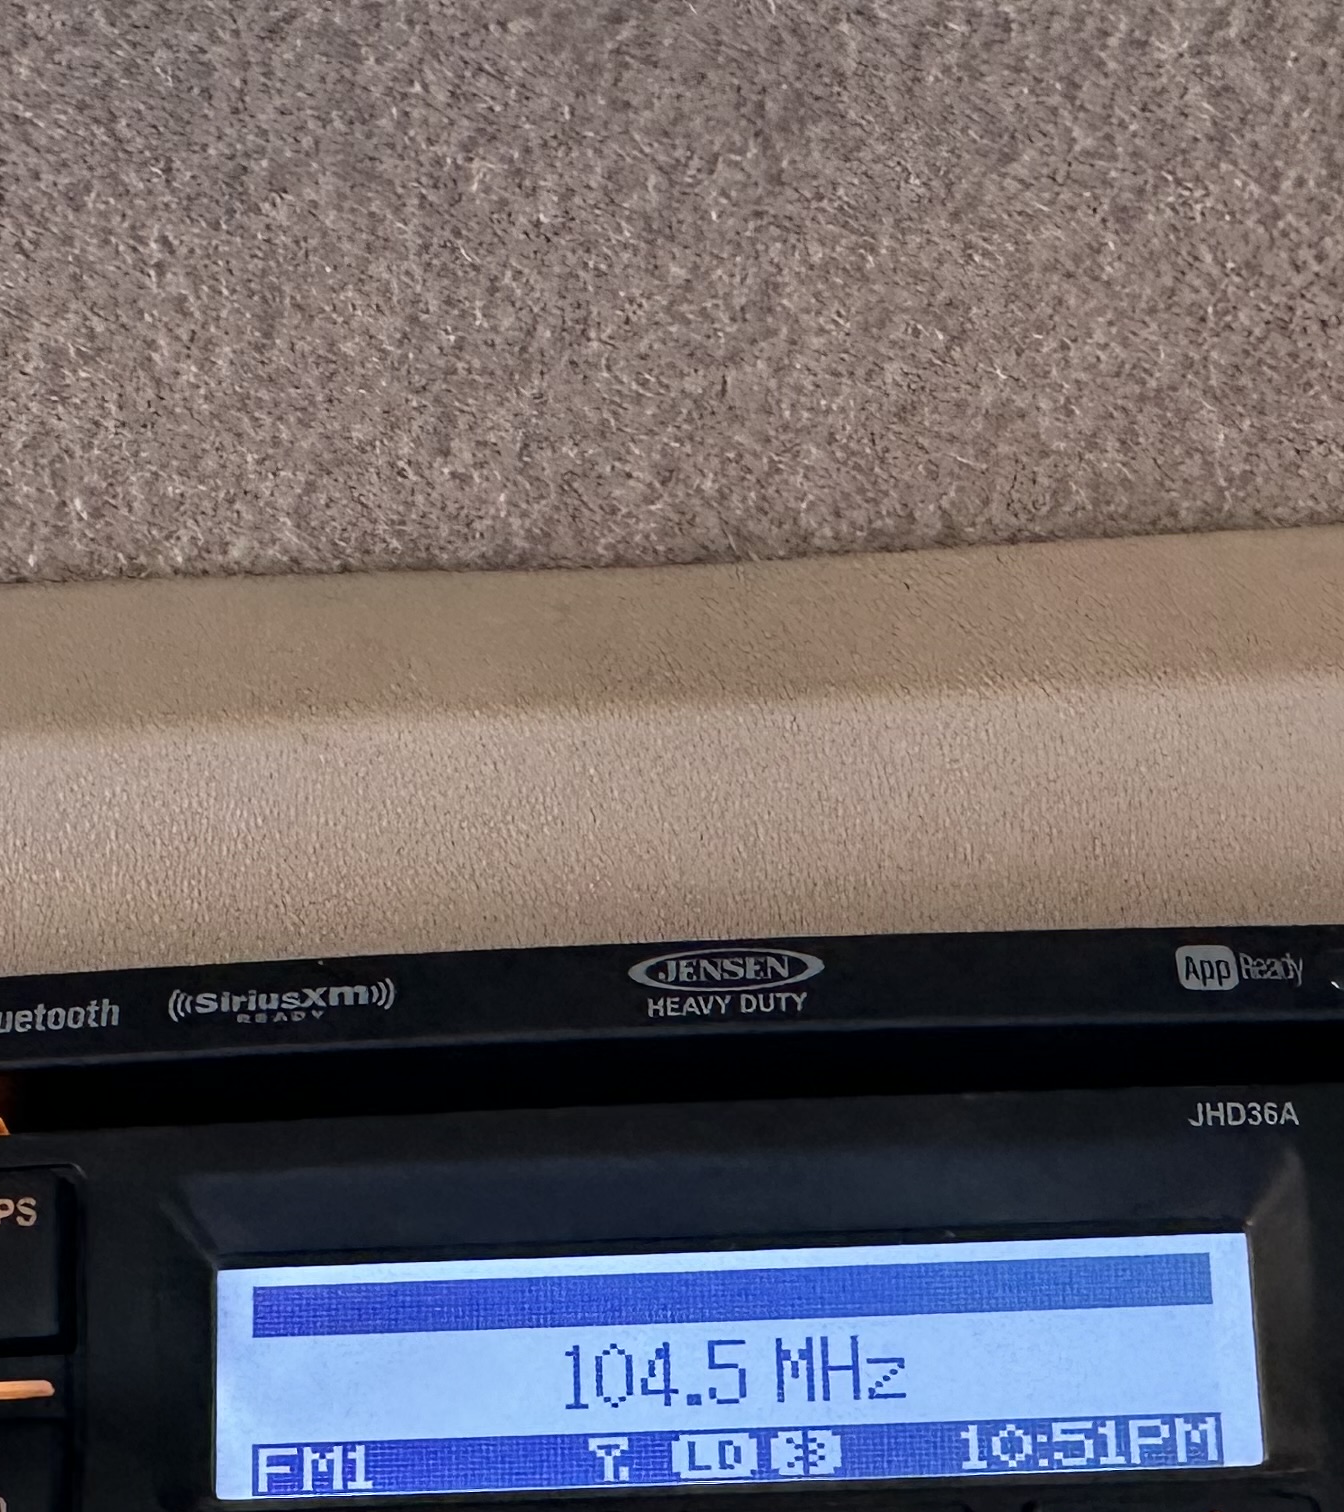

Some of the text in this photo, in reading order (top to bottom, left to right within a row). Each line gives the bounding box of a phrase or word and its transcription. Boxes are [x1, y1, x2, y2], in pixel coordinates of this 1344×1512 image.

[657, 955, 790, 983] JENSEN
[1184, 951, 1304, 988] App Ready
[236, 1009, 325, 1025] READY
[646, 991, 808, 1018] HEAVY DUTY
[1187, 1101, 1300, 1128] JHD36A
[564, 1335, 908, 1410] 104.5 MHz
[256, 1443, 375, 1494] FM1
